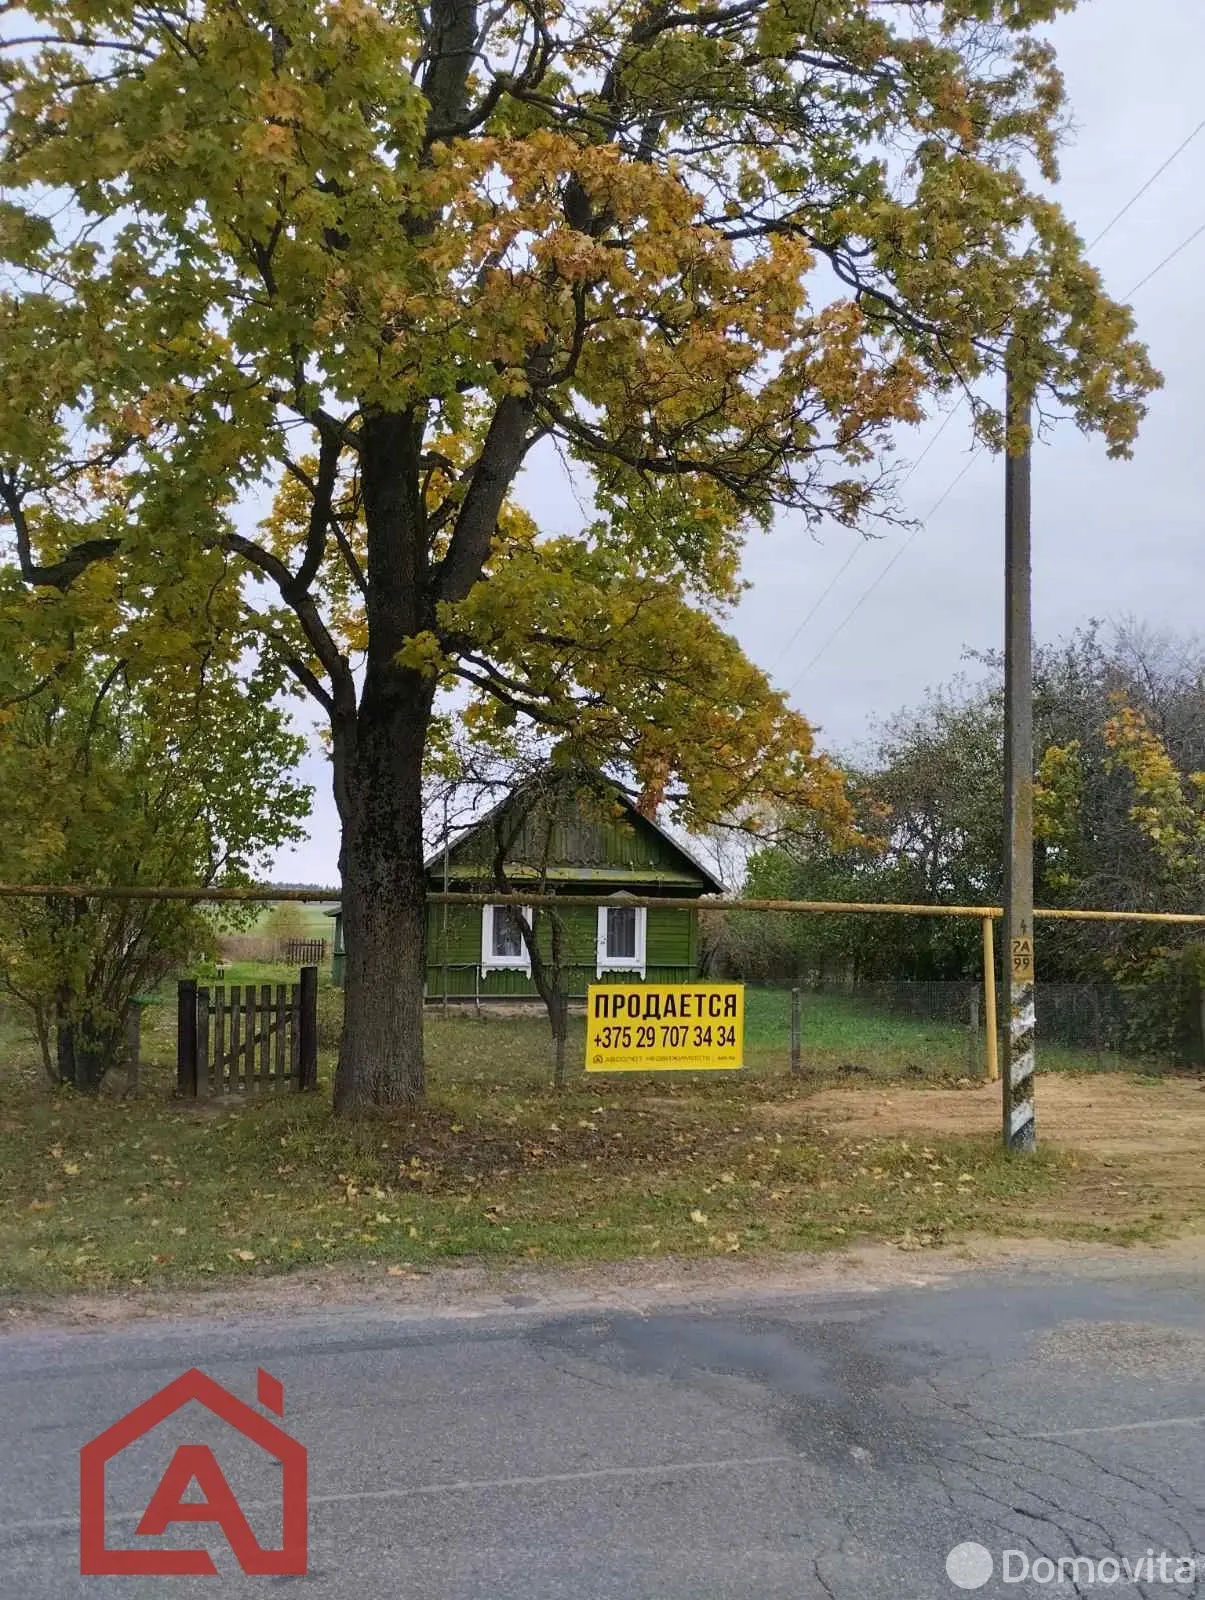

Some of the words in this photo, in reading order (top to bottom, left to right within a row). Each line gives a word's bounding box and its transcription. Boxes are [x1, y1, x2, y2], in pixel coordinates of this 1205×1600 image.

[1013, 957, 1030, 972] 99
[594, 993, 737, 1020] ПРОДАЕТСЯ
[594, 1026, 632, 1048] +375
[636, 1027, 656, 1048] 29
[660, 1025, 689, 1048] 707
[693, 1025, 713, 1047] 34
[717, 1025, 736, 1047] 34
